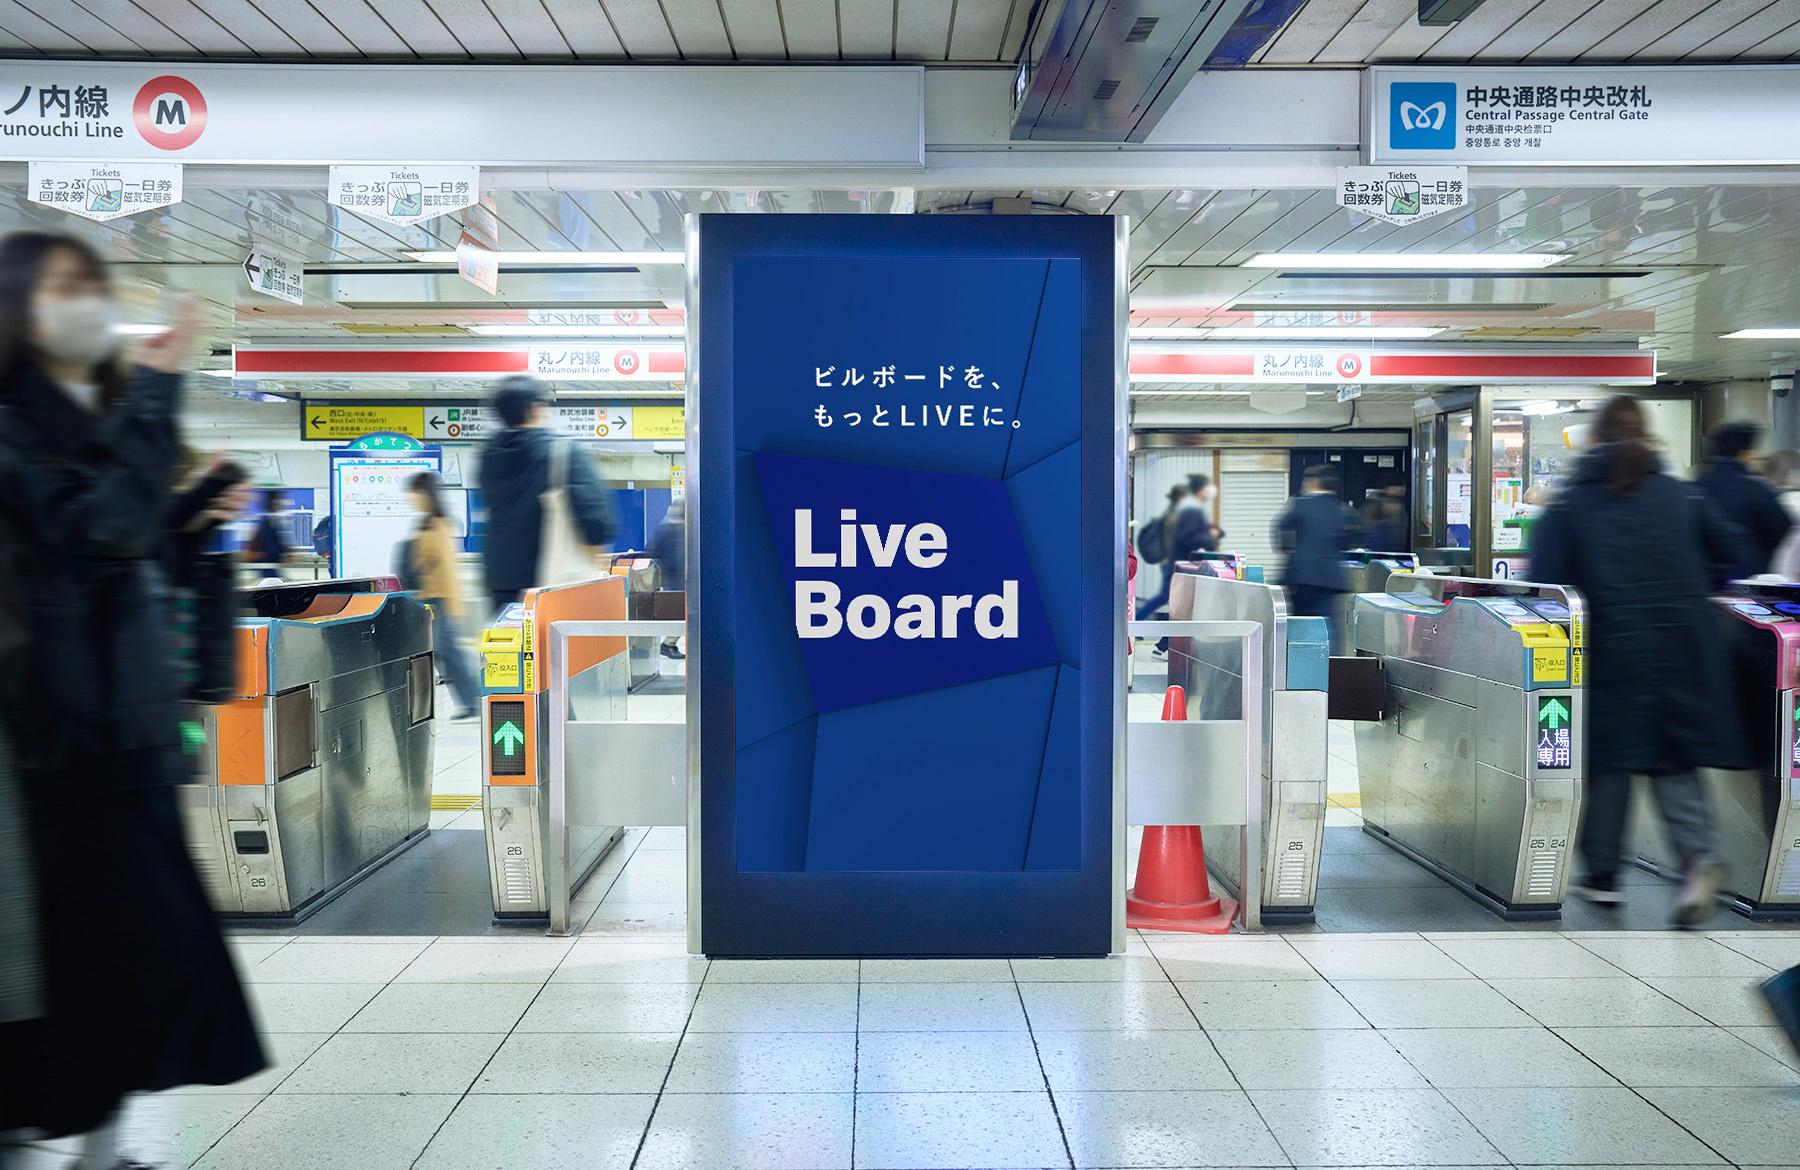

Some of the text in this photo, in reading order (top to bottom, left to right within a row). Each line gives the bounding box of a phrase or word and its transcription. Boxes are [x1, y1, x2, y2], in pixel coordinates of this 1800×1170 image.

[1466, 85, 1652, 108] 中央通路中央改札
[156, 100, 186, 125] M
[1465, 110, 1649, 123] Central Passage Central Gate
[86, 122, 124, 138] Line
[1465, 124, 1552, 134] 中央通道中央检票口
[1465, 137, 1541, 148] 중앙통로 중앙 개찰
[91, 168, 121, 177] Tickets
[390, 171, 420, 180] Tickets
[1388, 172, 1417, 180] Tickets
[41, 178, 173, 191] きっぷ 一日券
[341, 181, 470, 194] きっぷ 一日券
[1344, 180, 1463, 193] きっぷ 一日券
[39, 191, 85, 203] 回数券
[340, 194, 386, 206] 回数券
[1343, 193, 1384, 206] 回数券
[538, 351, 600, 365] 丸ノ内線
[621, 357, 633, 366] M
[1263, 354, 1324, 368] 丸ノ内線
[1343, 360, 1354, 370] M
[815, 365, 1000, 390] ビルボードを、
[814, 404, 1021, 429] もっとLIVEに。
[795, 509, 948, 568] Live
[795, 580, 1019, 639] Board
[1538, 729, 1570, 748] 入場
[1537, 748, 1570, 766] 専用
[1288, 841, 1303, 851] 25
[1530, 839, 1565, 848] 25 24
[507, 846, 522, 856] 26
[251, 878, 266, 887] 26
